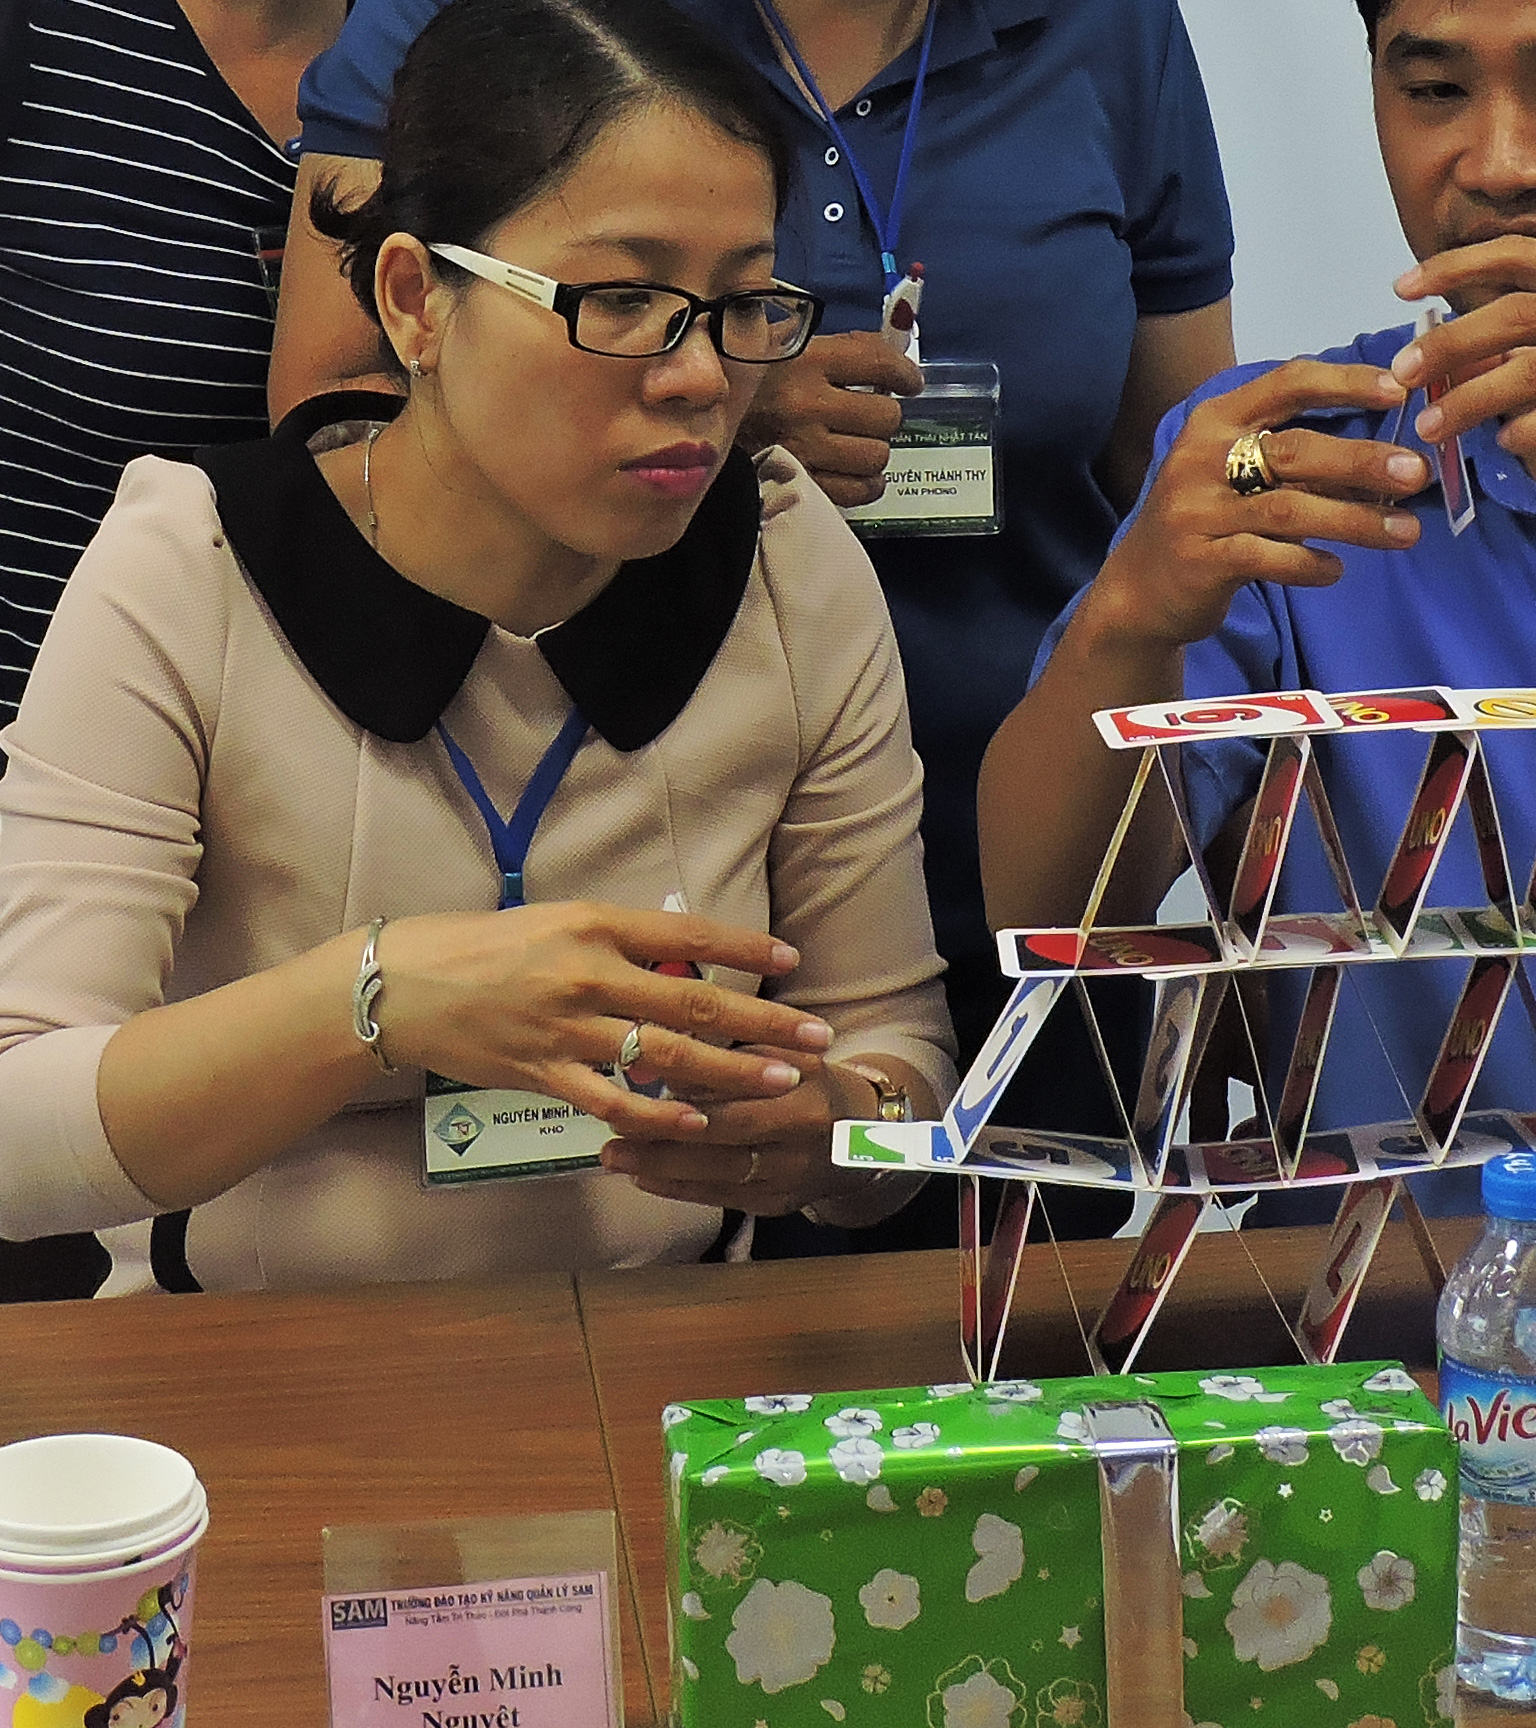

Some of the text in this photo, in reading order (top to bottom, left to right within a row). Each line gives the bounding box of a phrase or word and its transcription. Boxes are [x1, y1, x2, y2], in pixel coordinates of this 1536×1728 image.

[965, 469, 986, 481] THY
[539, 1124, 564, 1135] KHO
[456, 1593, 478, 1608] TẠO
[556, 1583, 568, 1598] LÝ
[572, 1584, 593, 1597] SAM
[333, 1598, 386, 1623] SAM
[374, 1663, 563, 1705] Nguyễn Minh
